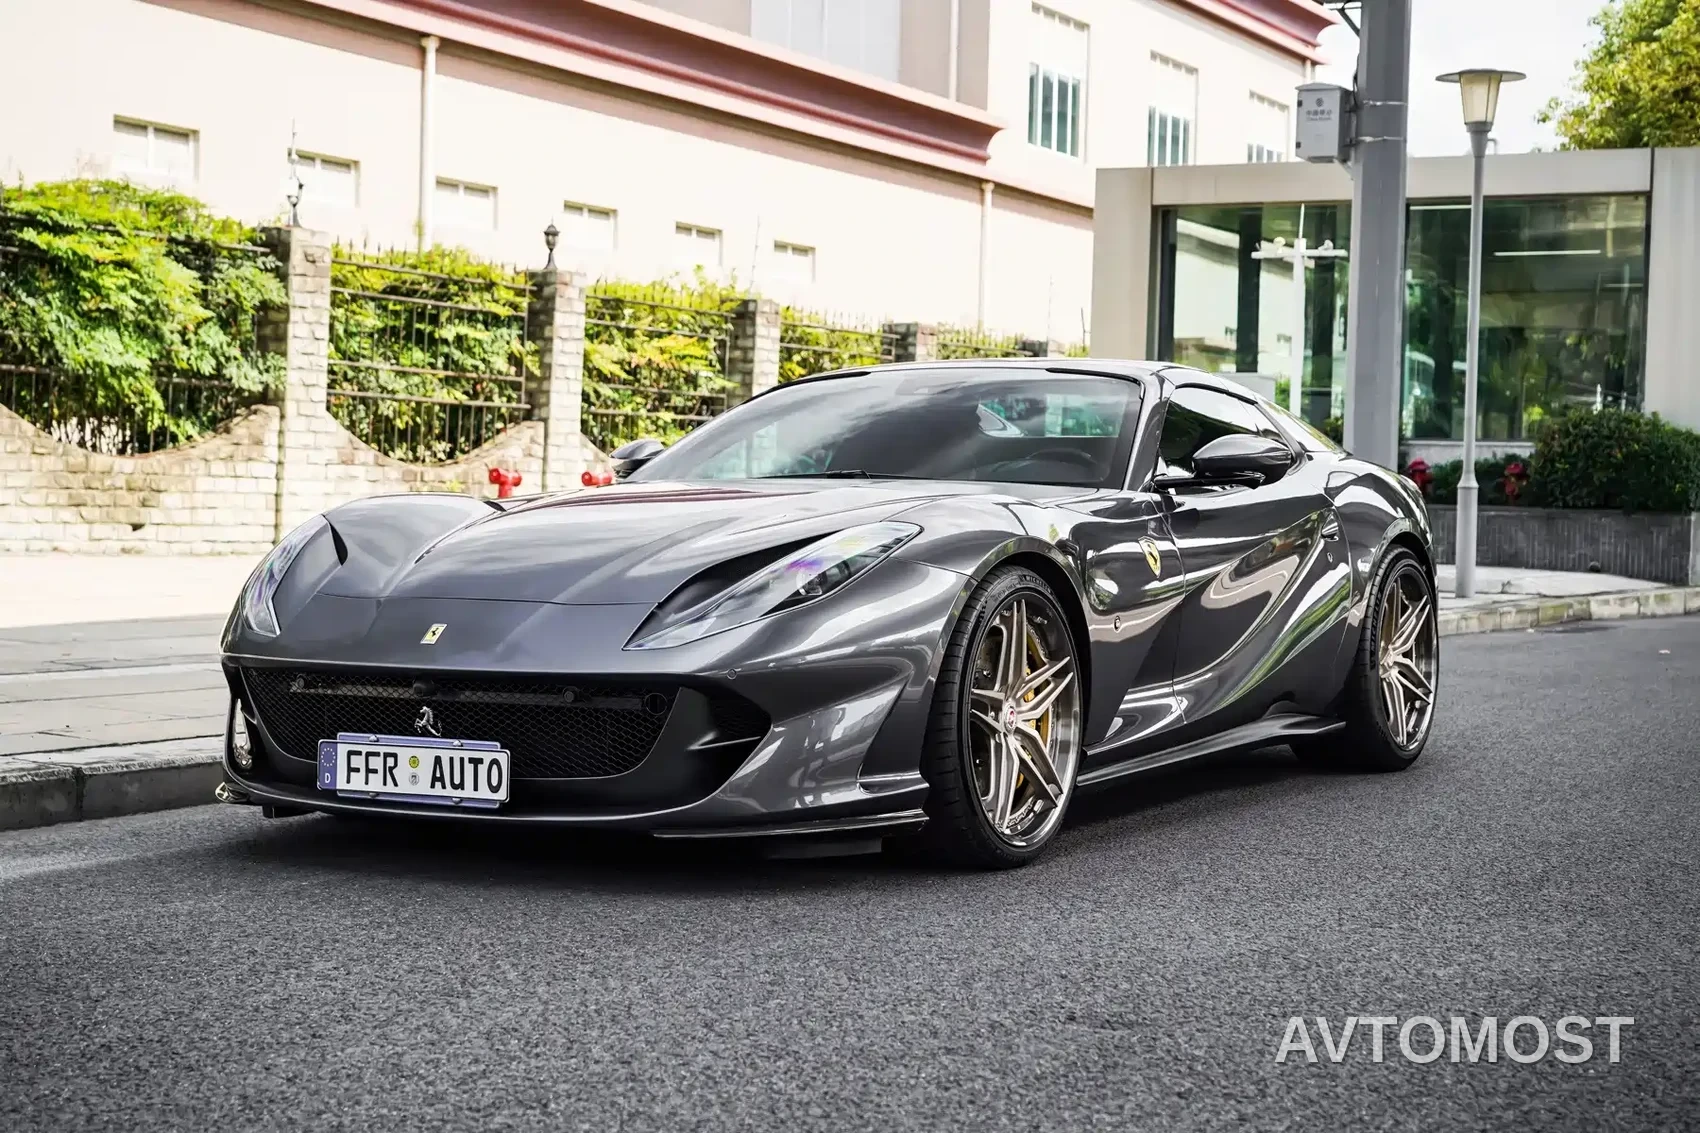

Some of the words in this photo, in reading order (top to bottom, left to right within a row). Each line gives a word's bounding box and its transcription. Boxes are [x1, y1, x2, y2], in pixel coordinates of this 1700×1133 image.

[324, 773, 331, 783] D
[346, 750, 399, 787] FFR
[430, 755, 503, 793] AUTO
